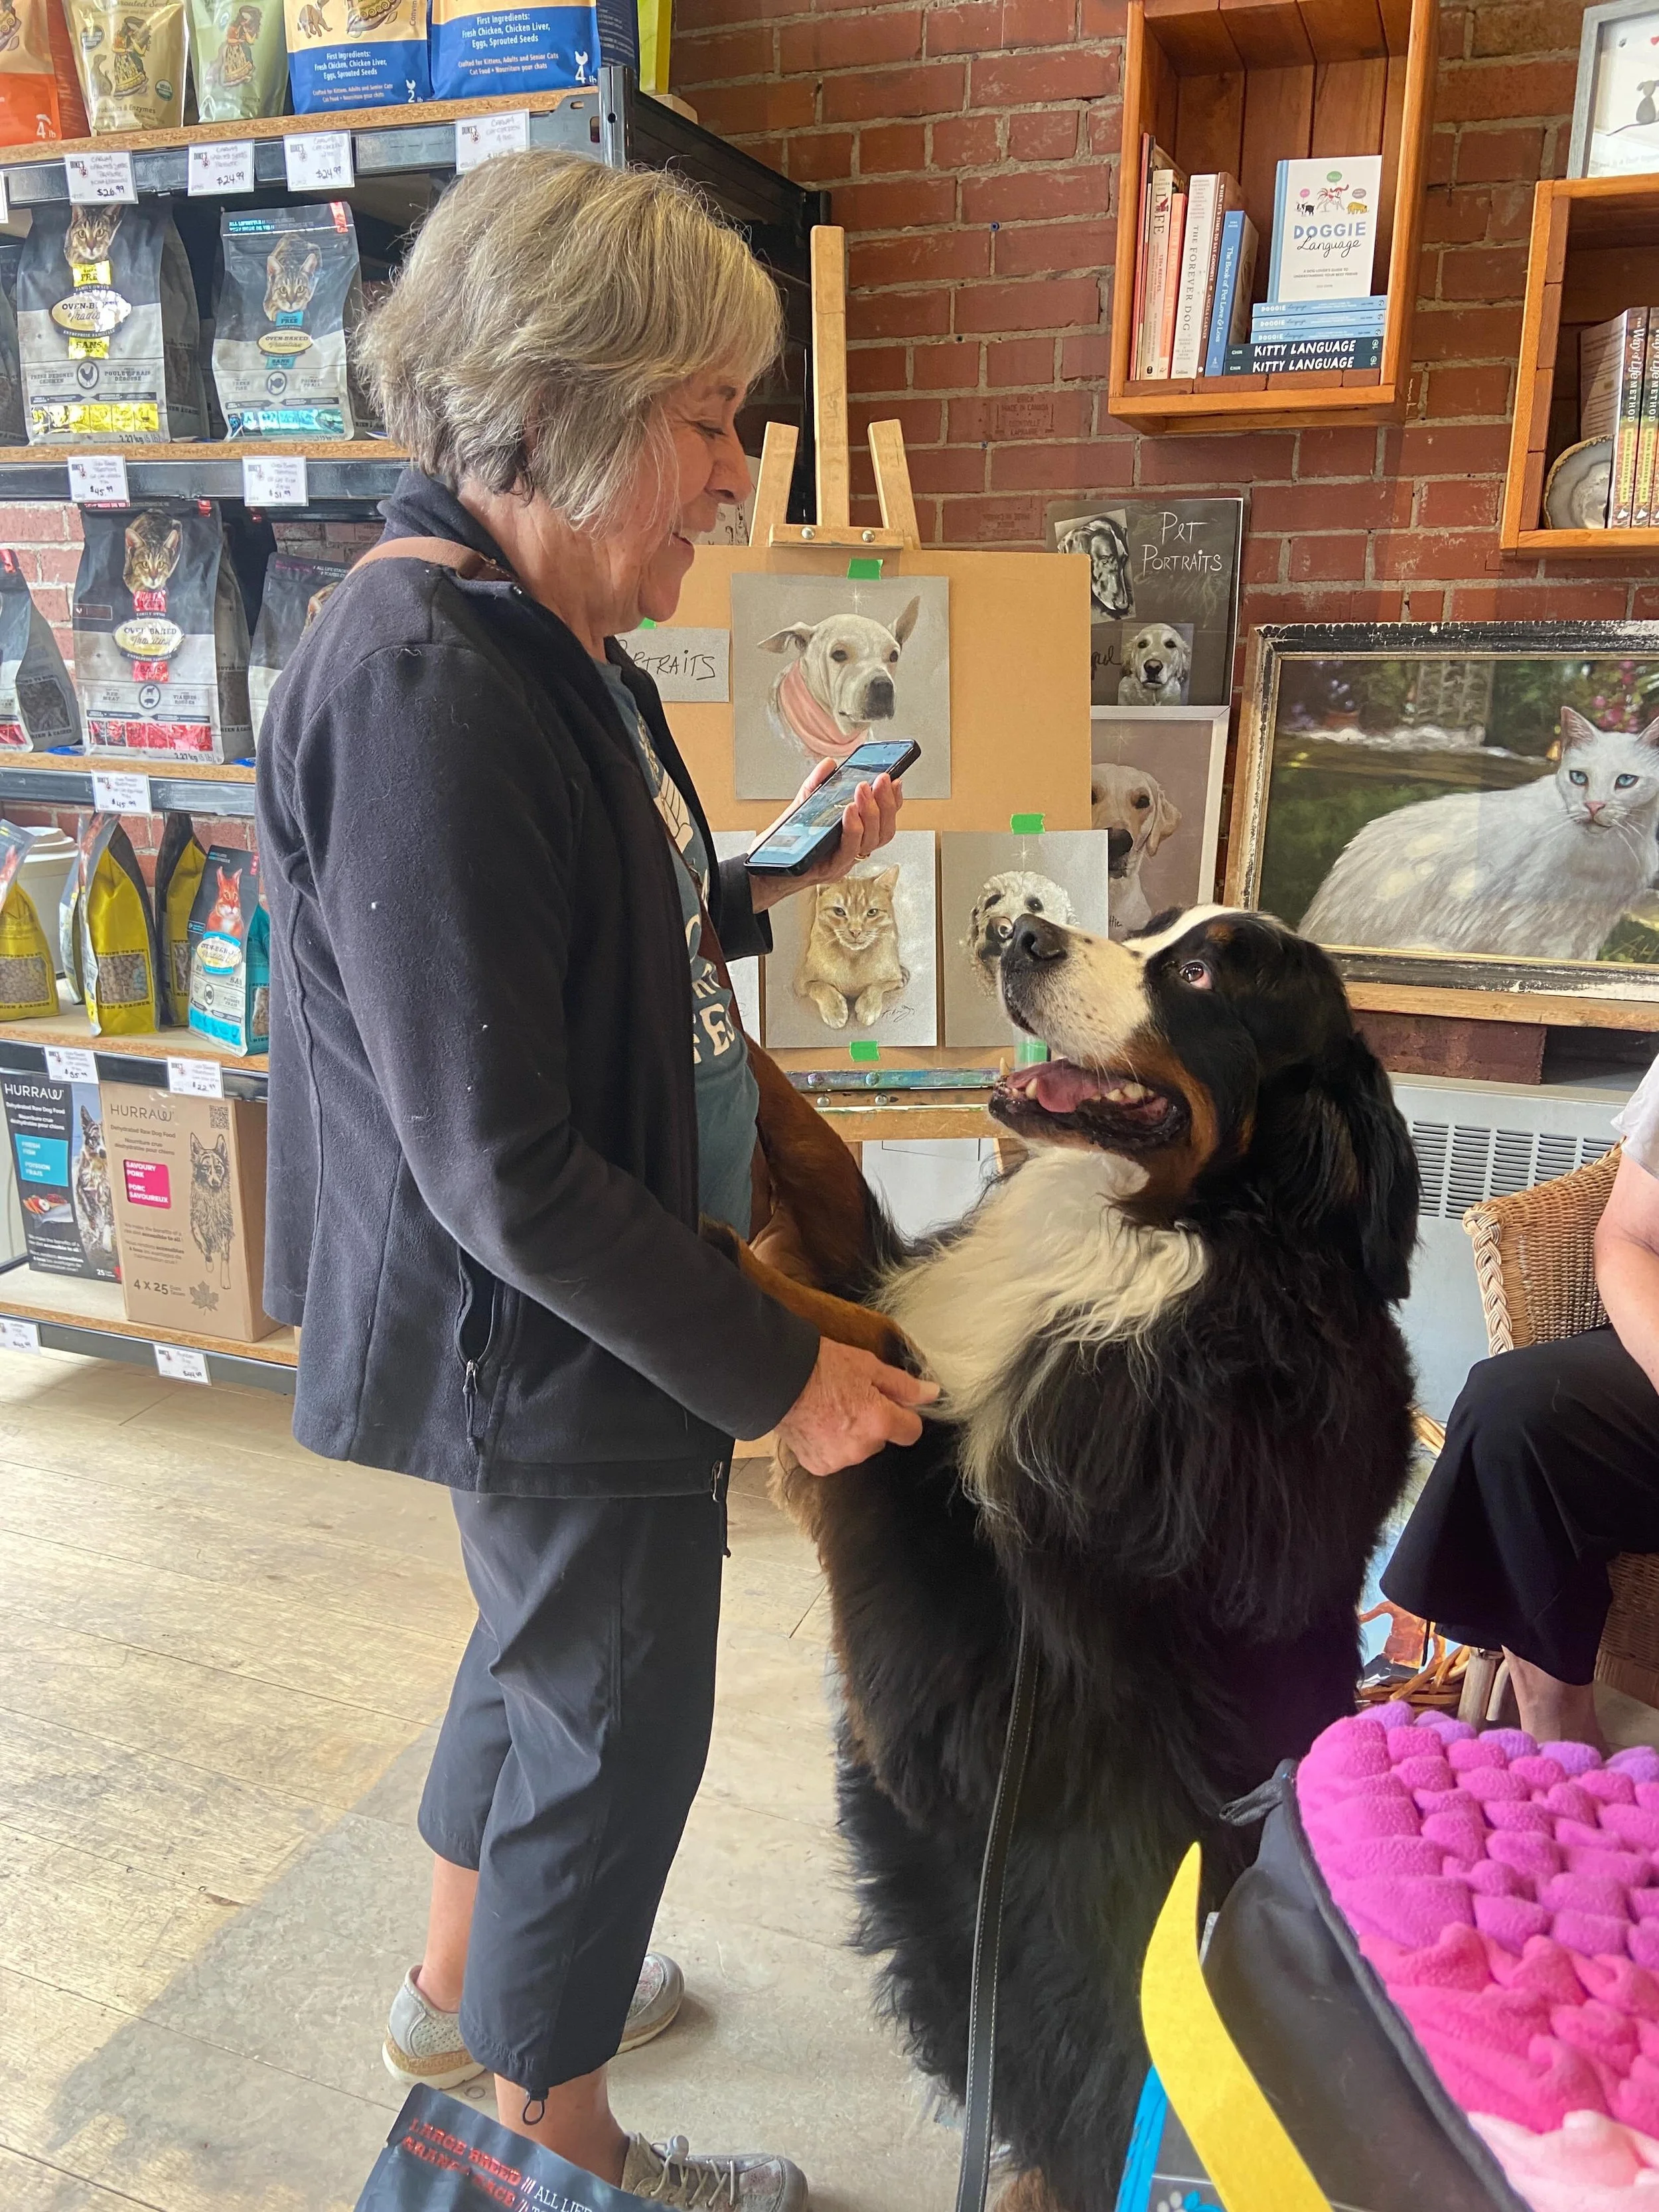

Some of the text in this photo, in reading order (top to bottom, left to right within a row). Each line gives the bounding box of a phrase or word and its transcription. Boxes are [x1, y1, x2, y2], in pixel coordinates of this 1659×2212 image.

[476, 13, 531, 26] First Ingredients:
[462, 22, 551, 38] Fresh Chicken, Chicken Liver,
[472, 35, 539, 50] Eggs, Sprouted Seeds
[338, 50, 371, 60] Ingredients:
[349, 58, 371, 67] Chicken
[323, 72, 336, 81] Eggs,
[337, 69, 360, 79] Sprouted
[575, 66, 586, 84] 4
[408, 90, 415, 102] 2
[36, 121, 46, 139] 4
[1214, 232, 1220, 242] TO
[1293, 222, 1366, 239] DOGGIE
[1226, 246, 1235, 259] The
[1297, 236, 1362, 258] Language
[1185, 247, 1198, 301] FOREVER
[1208, 254, 1217, 281] GOODBYE
[1224, 261, 1232, 279] Book
[1220, 288, 1229, 300] Pet
[1183, 306, 1192, 331] DOG
[1218, 301, 1227, 319] Love
[1214, 327, 1224, 342] Loss
[1629, 328, 1645, 352] Way
[1254, 344, 1287, 357] KITTY
[1290, 340, 1356, 355] LANGUAGE
[1252, 360, 1285, 373] KITTY
[1288, 356, 1354, 371] LANGUAGE
[1628, 360, 1642, 380] Life
[1627, 381, 1638, 423] METHOD
[1649, 381, 1658, 423] METHOD
[4, 1083, 62, 1100] HURRAW
[110, 1104, 172, 1122] HURRAW
[126, 1161, 156, 1171] SAVOURY
[129, 1183, 145, 1192] PORC
[129, 1192, 169, 1203] SAVOUREUX
[133, 1279, 140, 1290] 4
[154, 1282, 169, 1295] 25
[409, 2117, 467, 2156] LARGE
[468, 2148, 522, 2186] BREED
[534, 2185, 558, 2209] ALL
